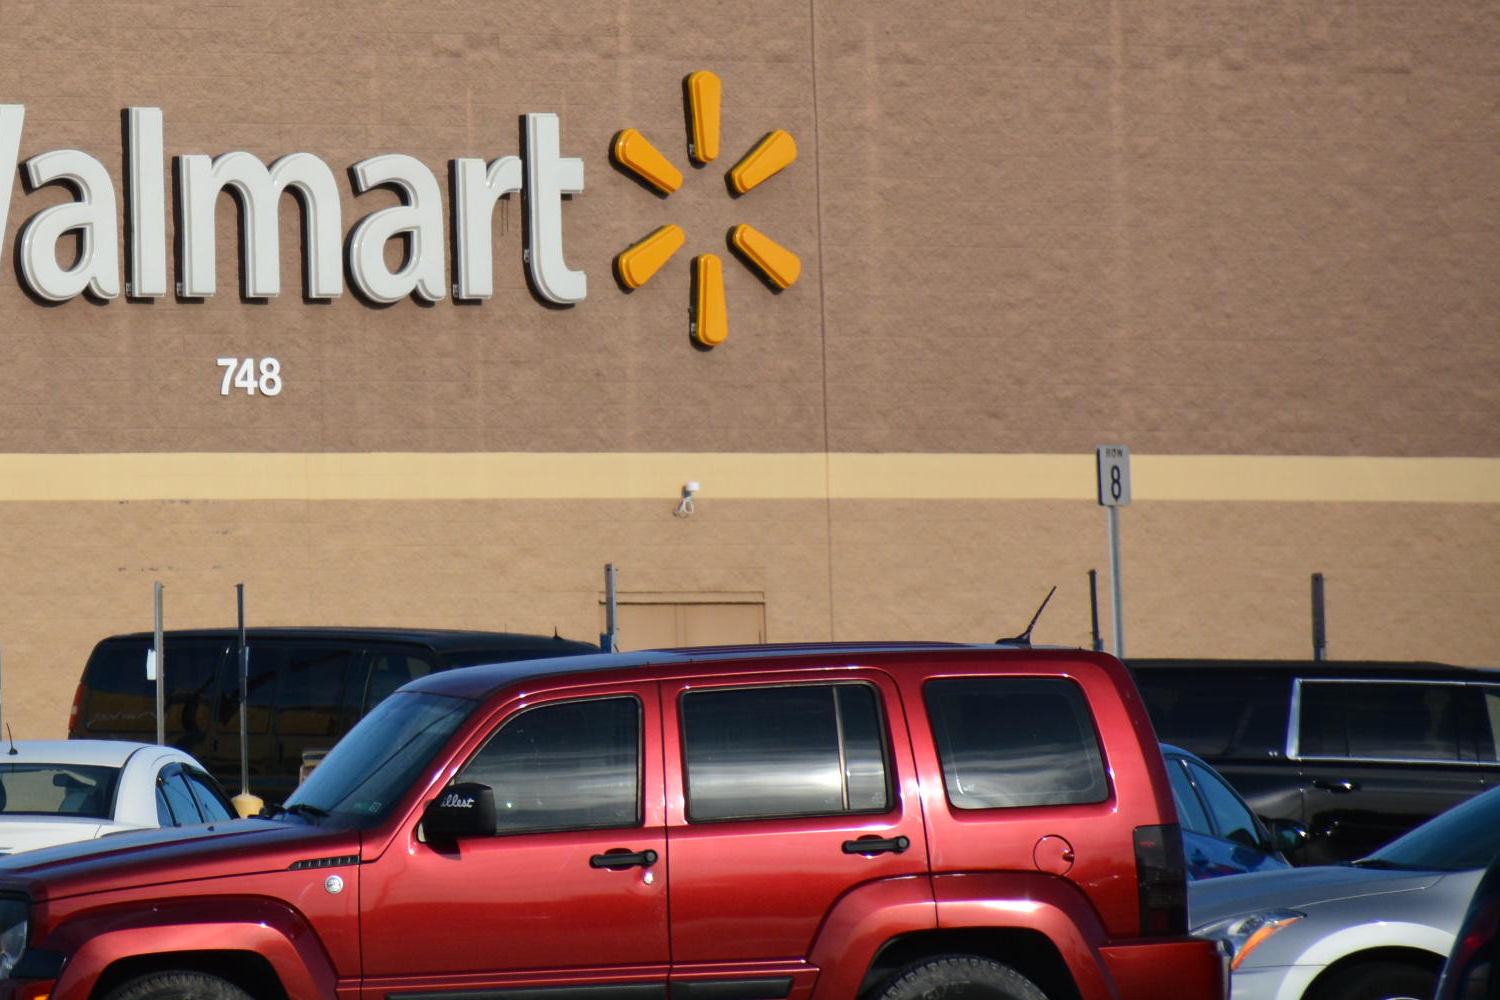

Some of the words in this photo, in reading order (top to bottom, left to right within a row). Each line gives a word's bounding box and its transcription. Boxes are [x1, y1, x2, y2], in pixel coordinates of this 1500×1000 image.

[216, 357, 282, 396] 748
[1105, 448, 1123, 457] ROW
[1110, 464, 1122, 500] 8
